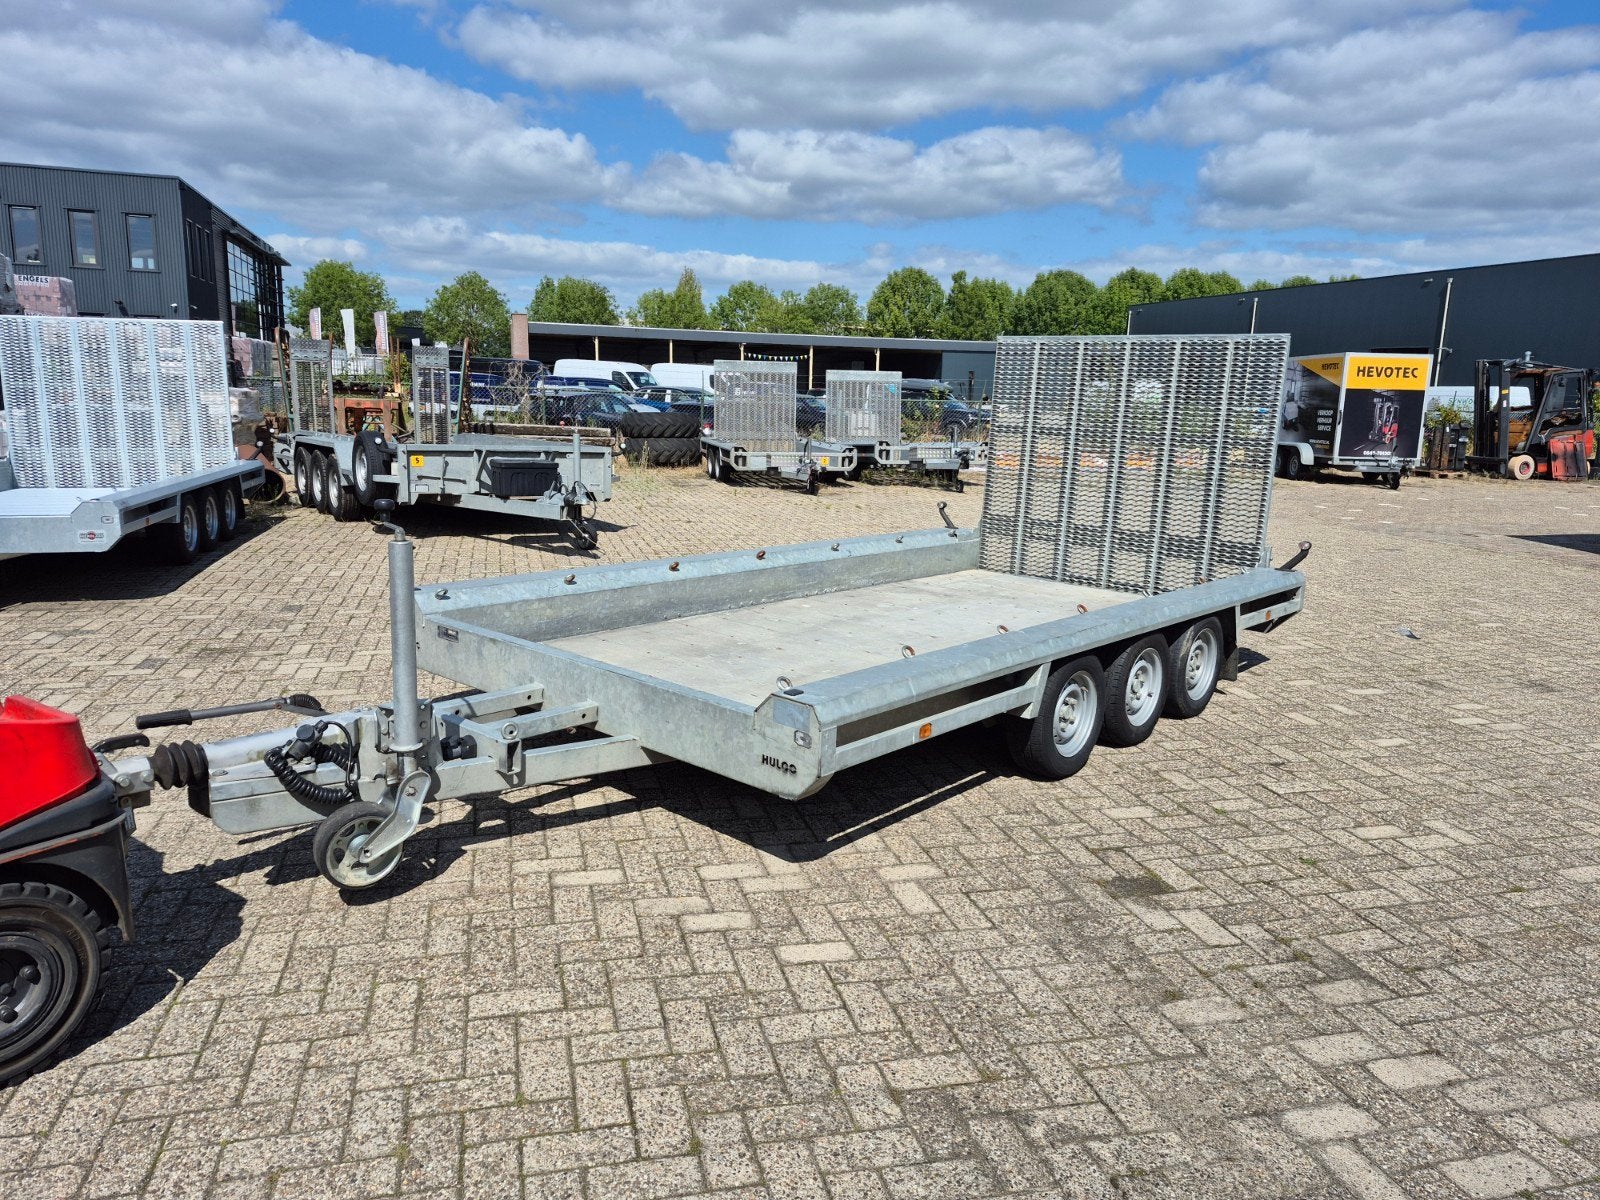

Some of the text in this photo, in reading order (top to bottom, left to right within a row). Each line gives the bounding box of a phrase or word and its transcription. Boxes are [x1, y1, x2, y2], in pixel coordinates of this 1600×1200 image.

[18, 275, 49, 283] ENGELS
[1321, 362, 1340, 370] HEVOTEC
[1356, 366, 1418, 378] HEVOTEC
